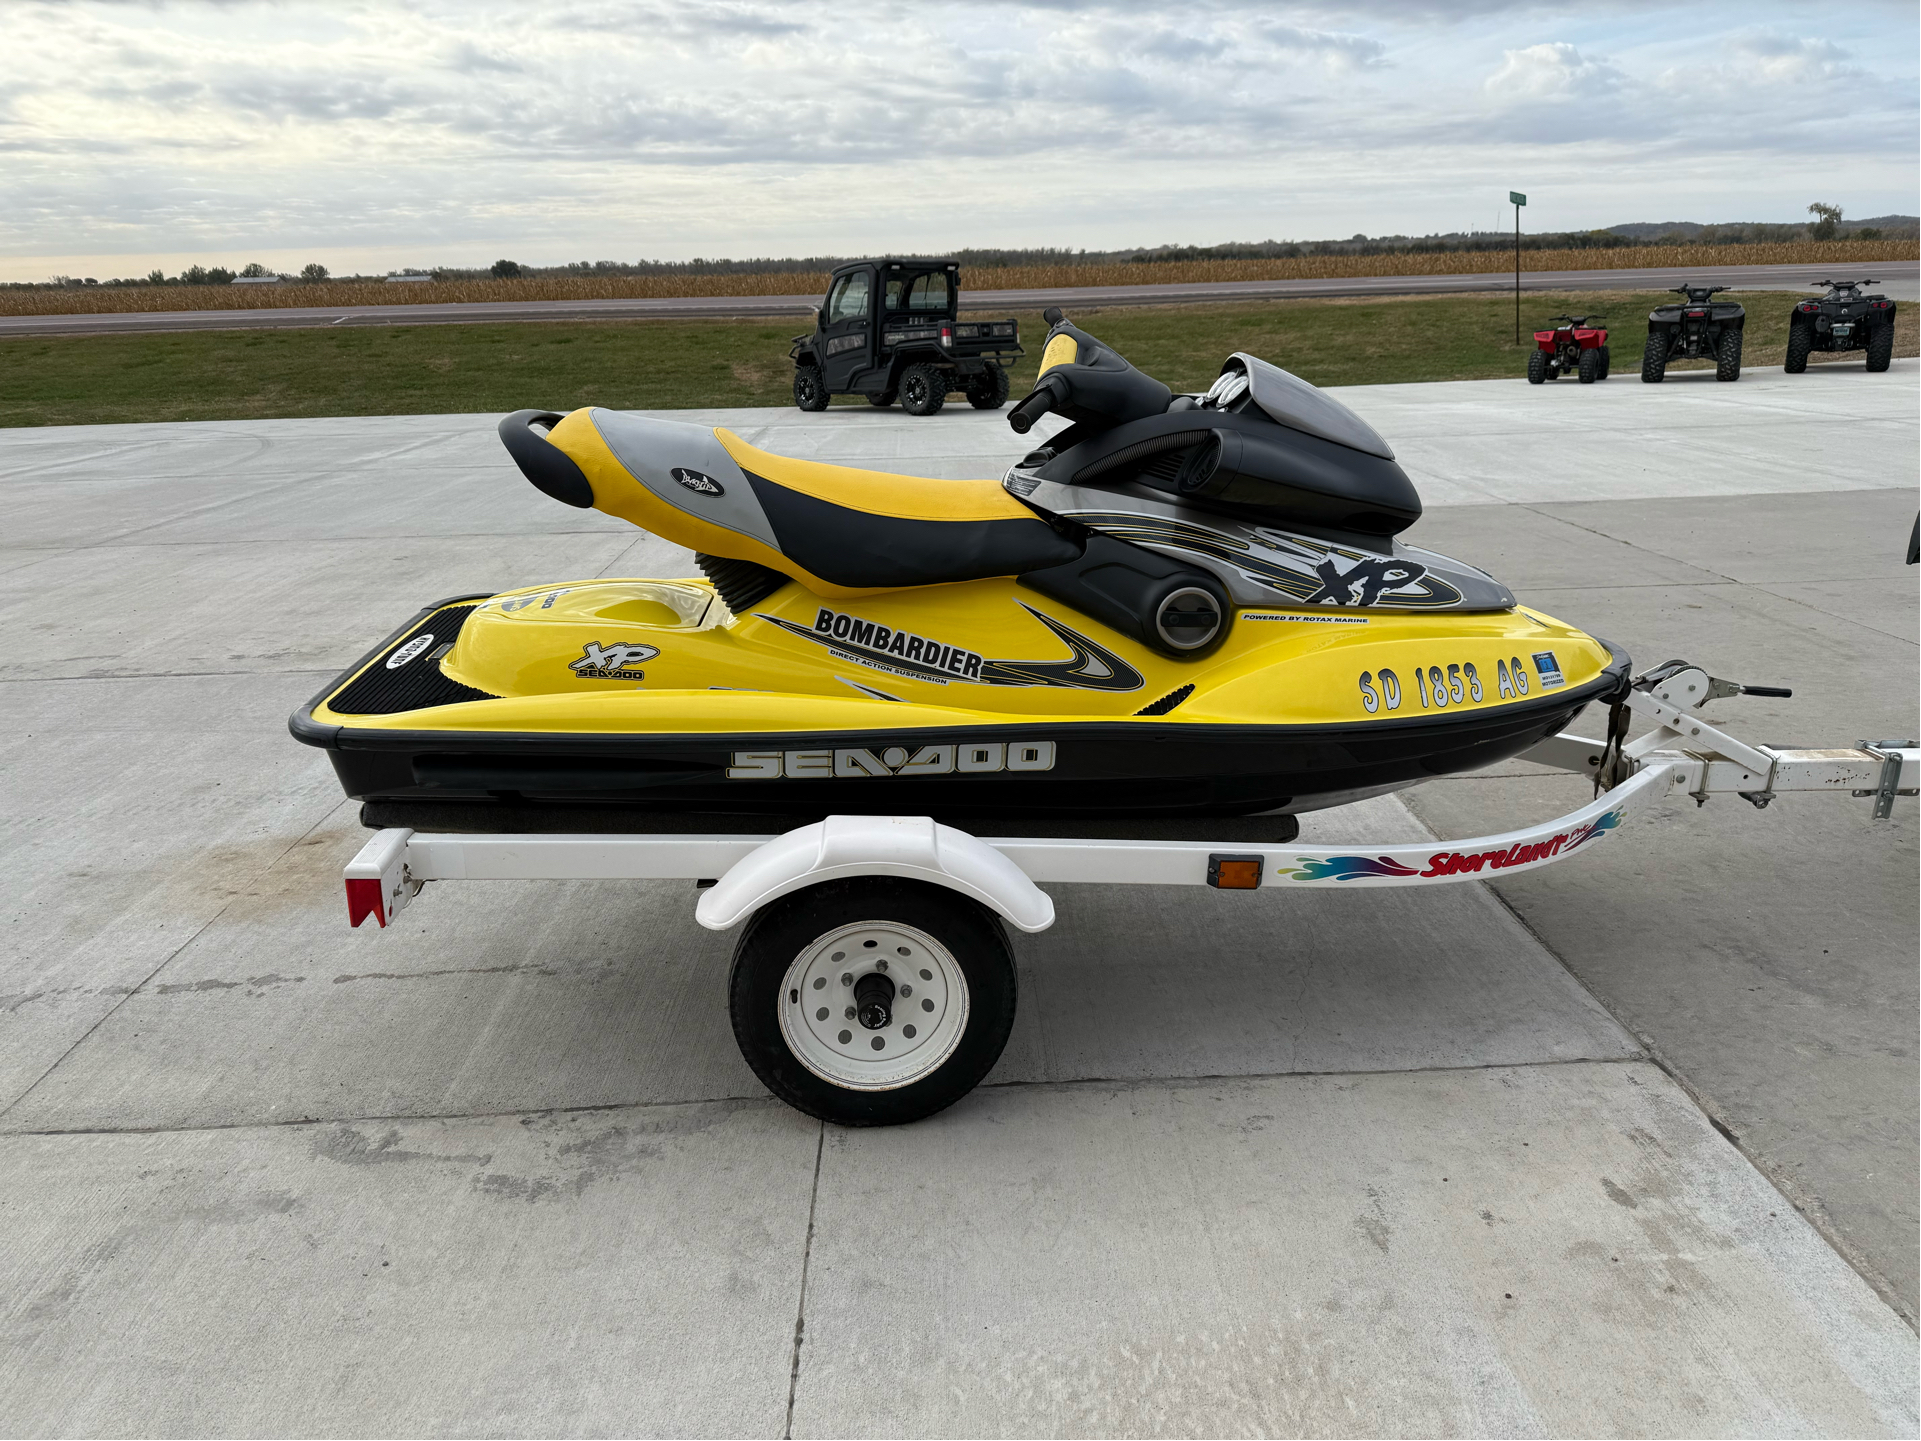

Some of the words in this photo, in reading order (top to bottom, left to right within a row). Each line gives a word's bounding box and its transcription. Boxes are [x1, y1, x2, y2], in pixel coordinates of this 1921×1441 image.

[1243, 614, 1287, 622] POWERED
[568, 641, 660, 672] XP
[814, 607, 983, 680] BOMBARDIER
[829, 649, 861, 663] DIRECT
[861, 659, 893, 673] ACTION
[894, 668, 948, 685] SUSPENSION
[1359, 668, 1402, 713] SD
[1415, 662, 1484, 709] 1853
[1497, 656, 1530, 700] AG
